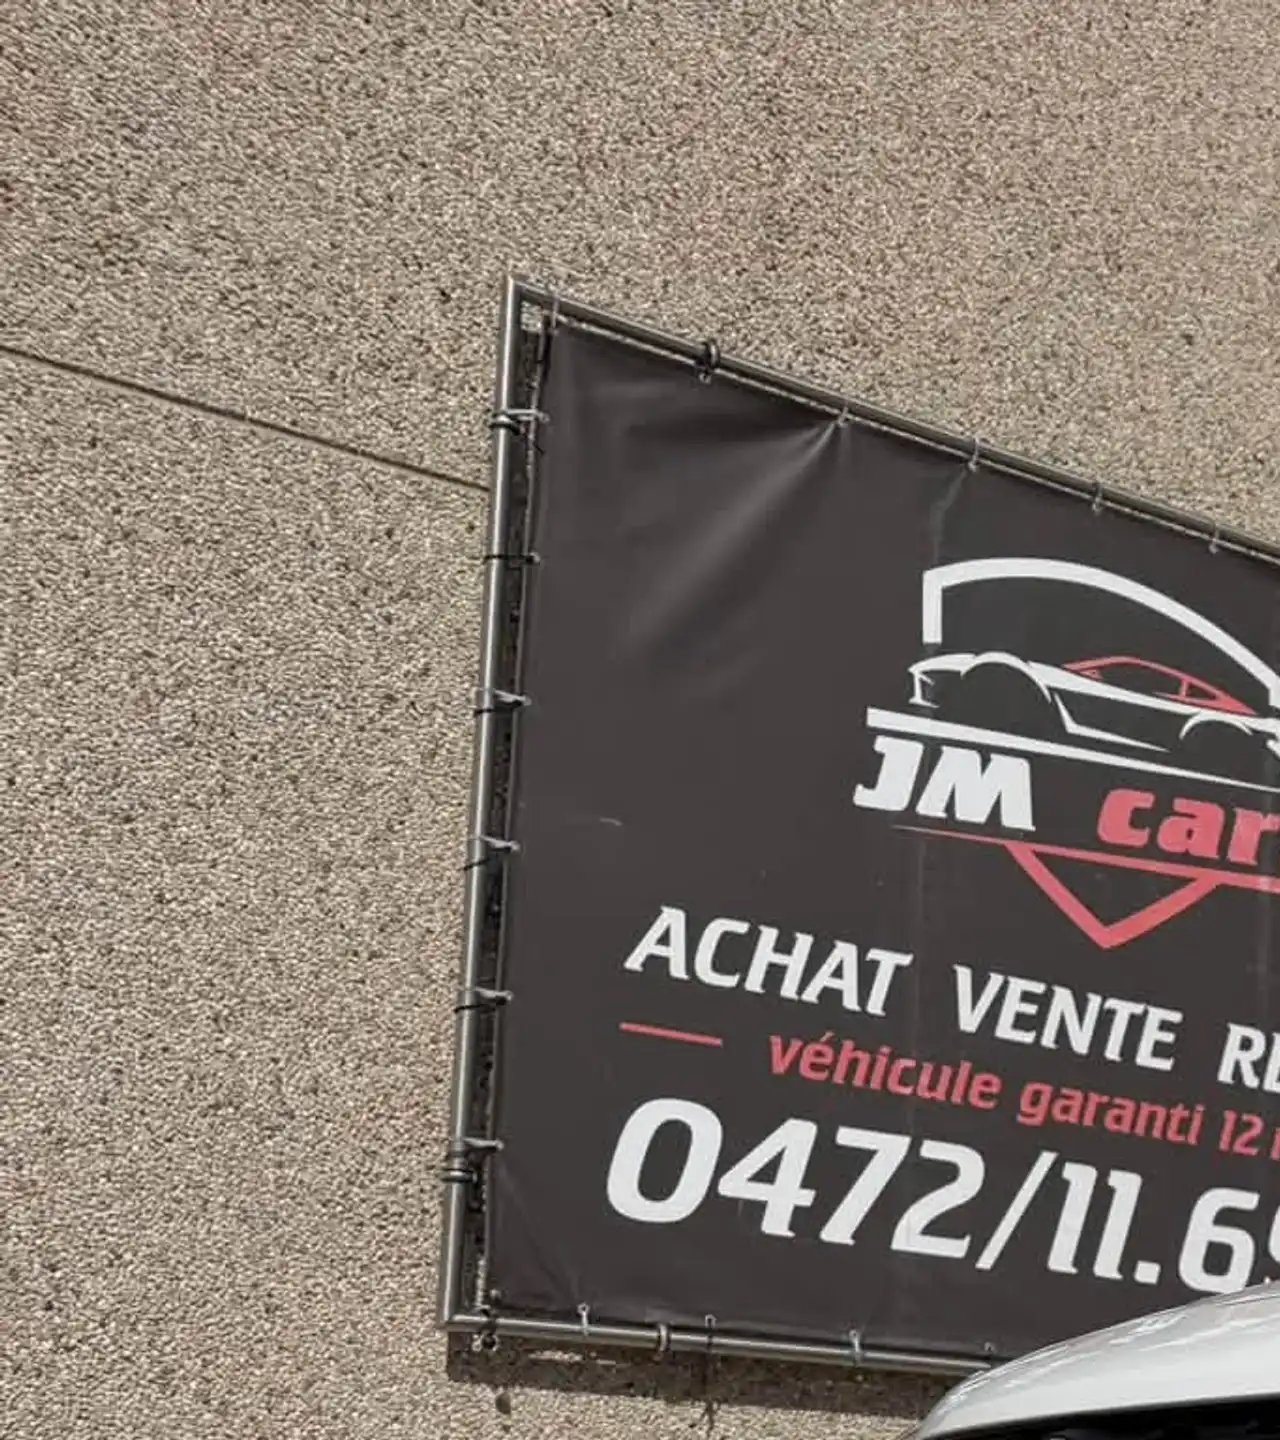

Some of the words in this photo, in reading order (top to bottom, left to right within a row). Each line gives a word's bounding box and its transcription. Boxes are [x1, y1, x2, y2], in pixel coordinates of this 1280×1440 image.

[853, 736, 1035, 831] JM
[624, 907, 913, 1017] ACHAT
[953, 964, 1183, 1070] VENTE
[771, 1033, 1001, 1109] véhicule
[1018, 1076, 1202, 1144] garanti
[1219, 1110, 1263, 1156] 12
